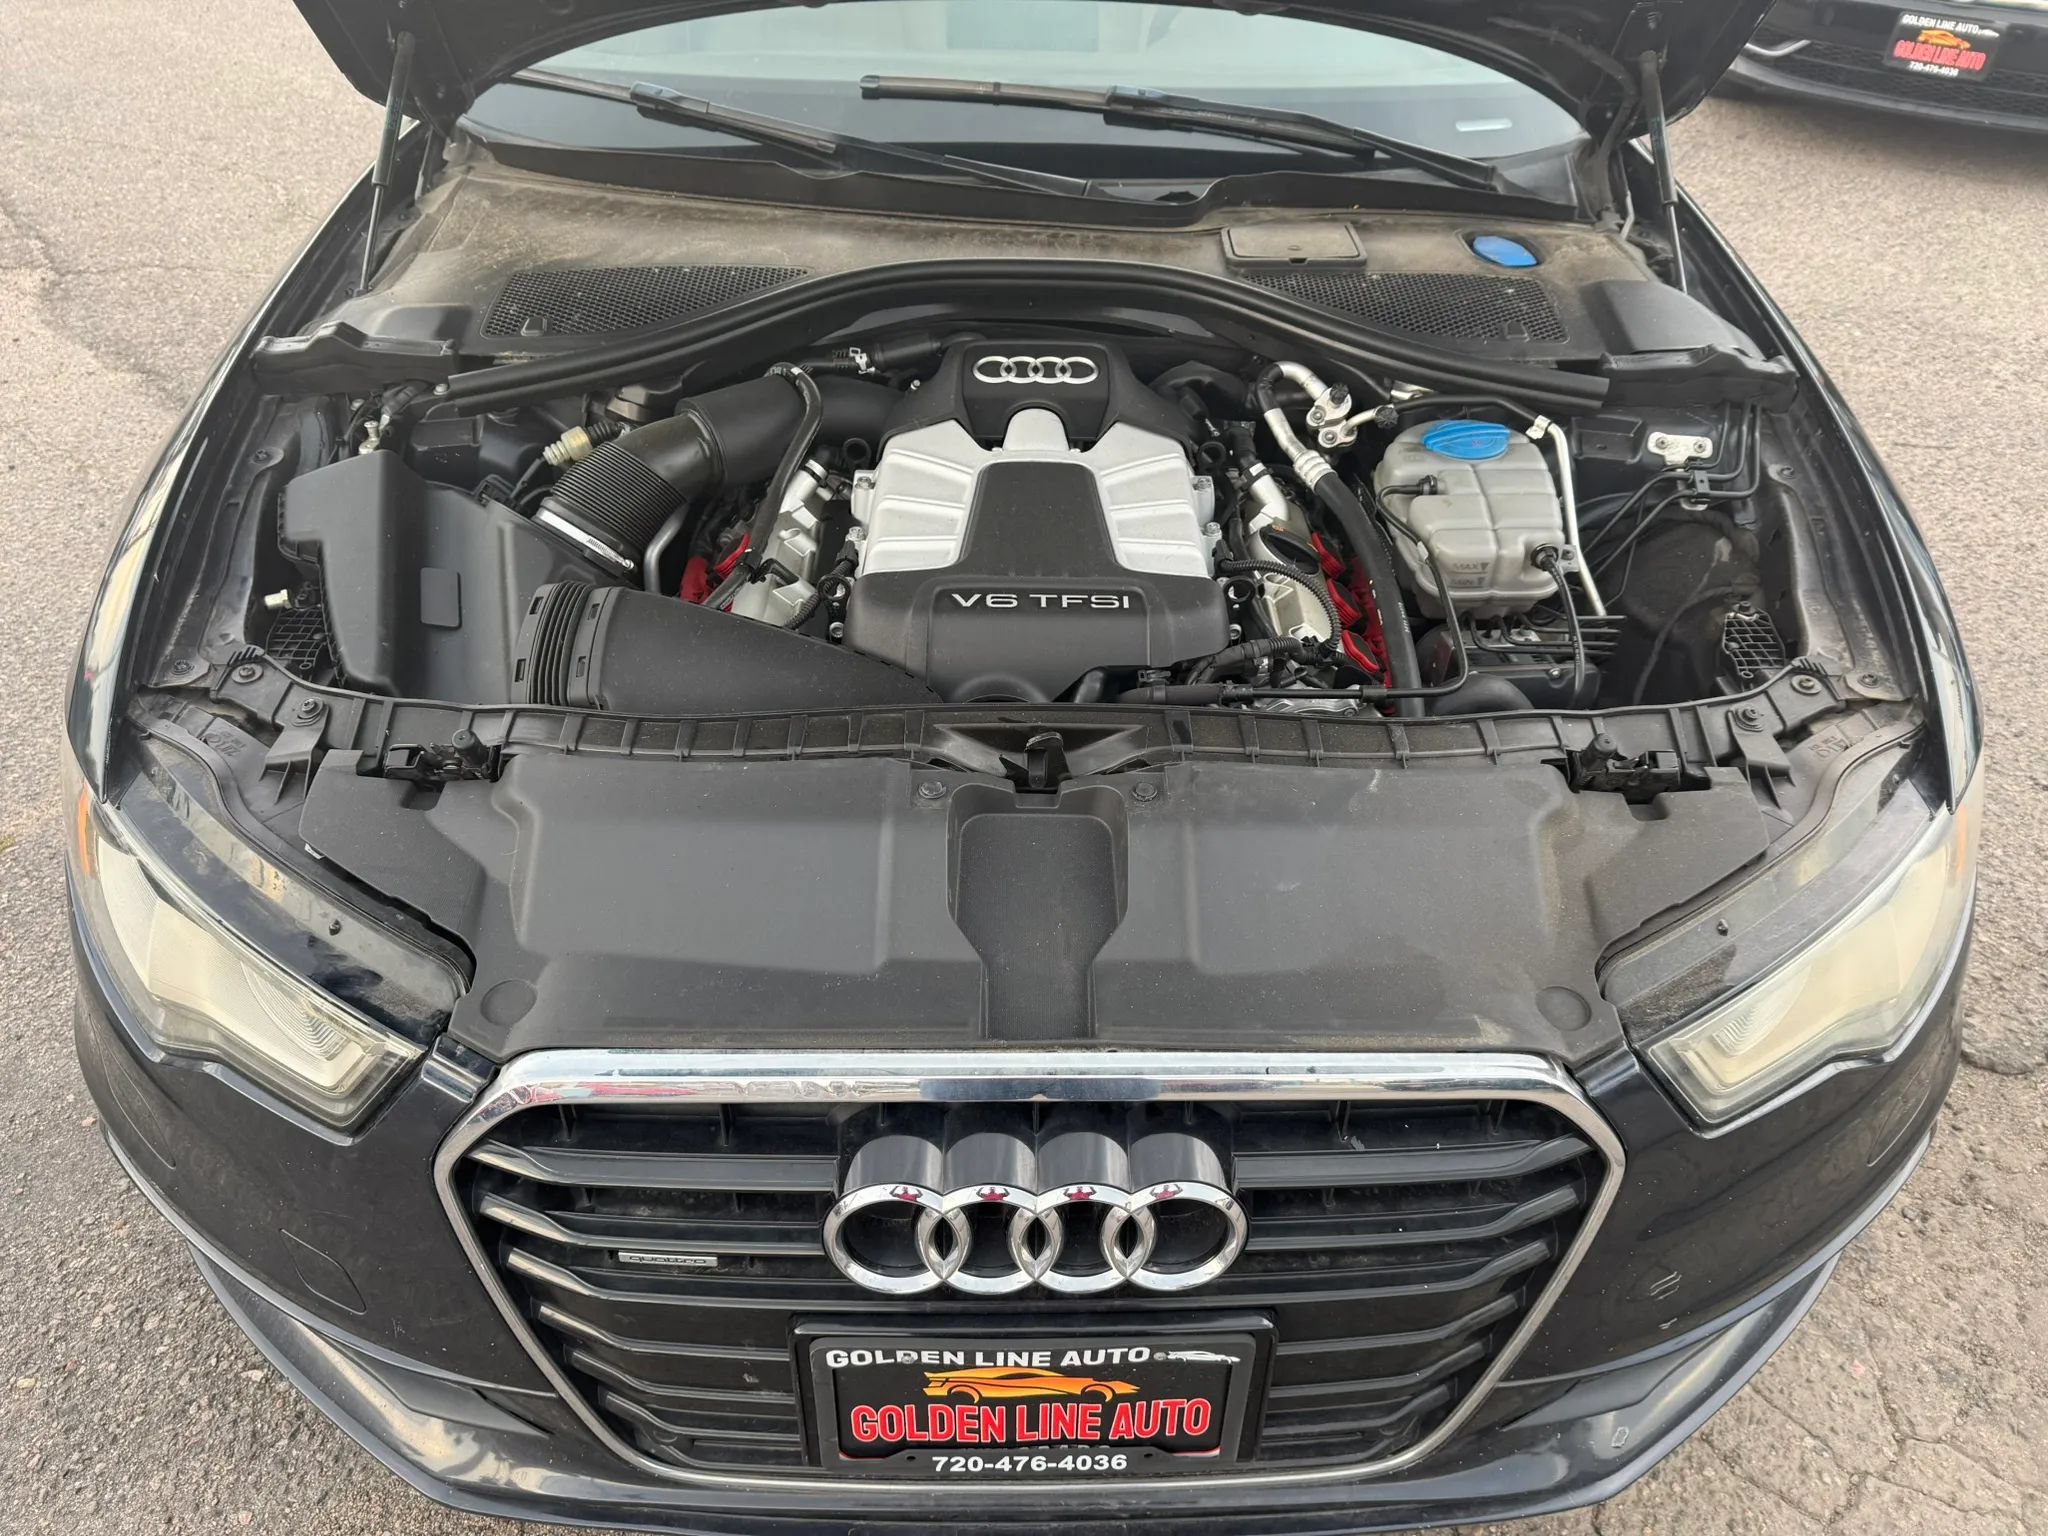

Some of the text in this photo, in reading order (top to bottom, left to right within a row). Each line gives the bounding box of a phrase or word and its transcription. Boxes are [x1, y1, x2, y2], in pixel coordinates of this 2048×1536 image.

[1902, 14, 1979, 34] GOLDEN LINE AUTO
[1894, 40, 1986, 70] GOLDEN LINE AUTO
[952, 593, 1130, 609] V6 TFSI
[630, 1256, 706, 1265] quattro
[826, 1347, 1151, 1368] GOLDEN LINE AUTO
[850, 1398, 1212, 1444] GOLDEN LINE AUTO
[932, 1454, 1128, 1472] 720-476-4036
